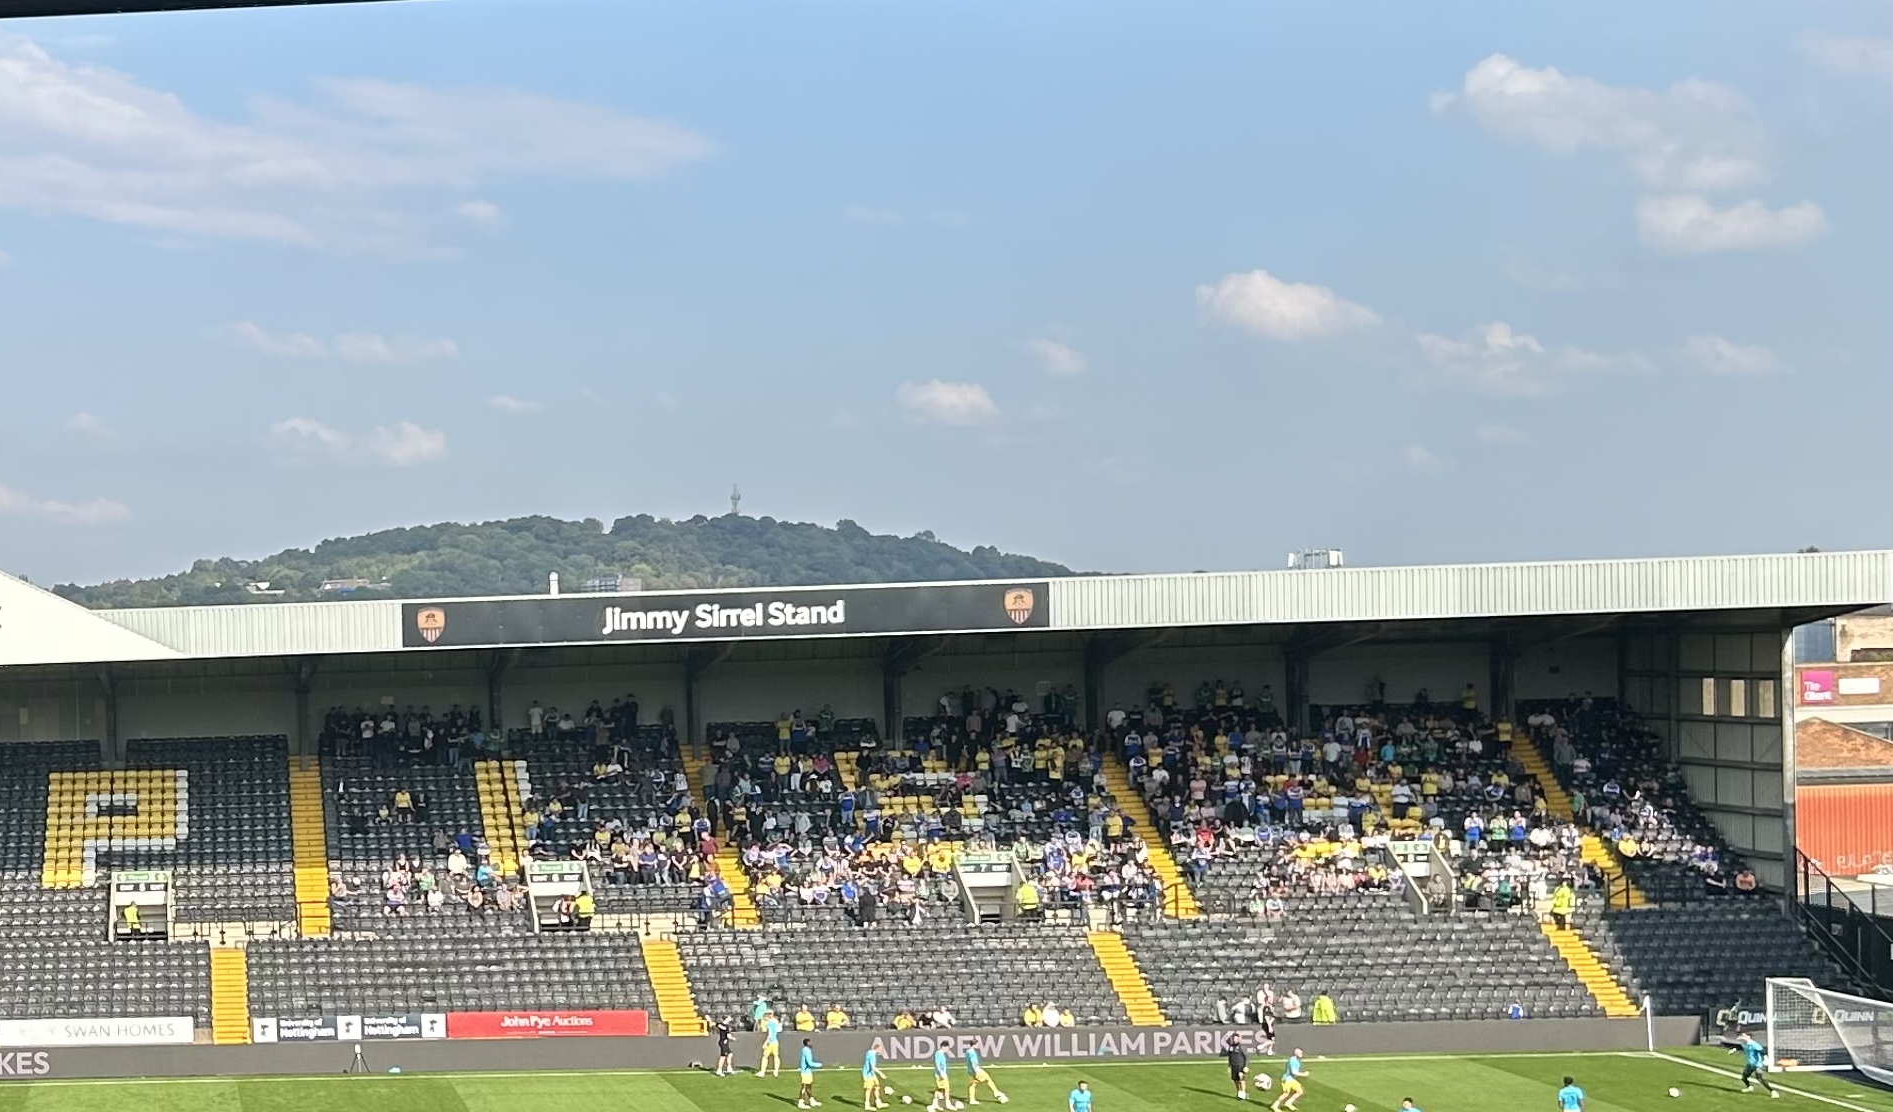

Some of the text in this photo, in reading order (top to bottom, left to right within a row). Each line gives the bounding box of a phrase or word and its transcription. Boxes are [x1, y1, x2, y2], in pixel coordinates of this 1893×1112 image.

[602, 599, 846, 635] Jimmy Sirrel Stand
[64, 1023, 175, 1038] SWAN HOMES
[500, 1015, 594, 1029] John Pye Auctions
[870, 1035, 1008, 1060] ANDREW
[1012, 1031, 1146, 1058] WILLIAM
